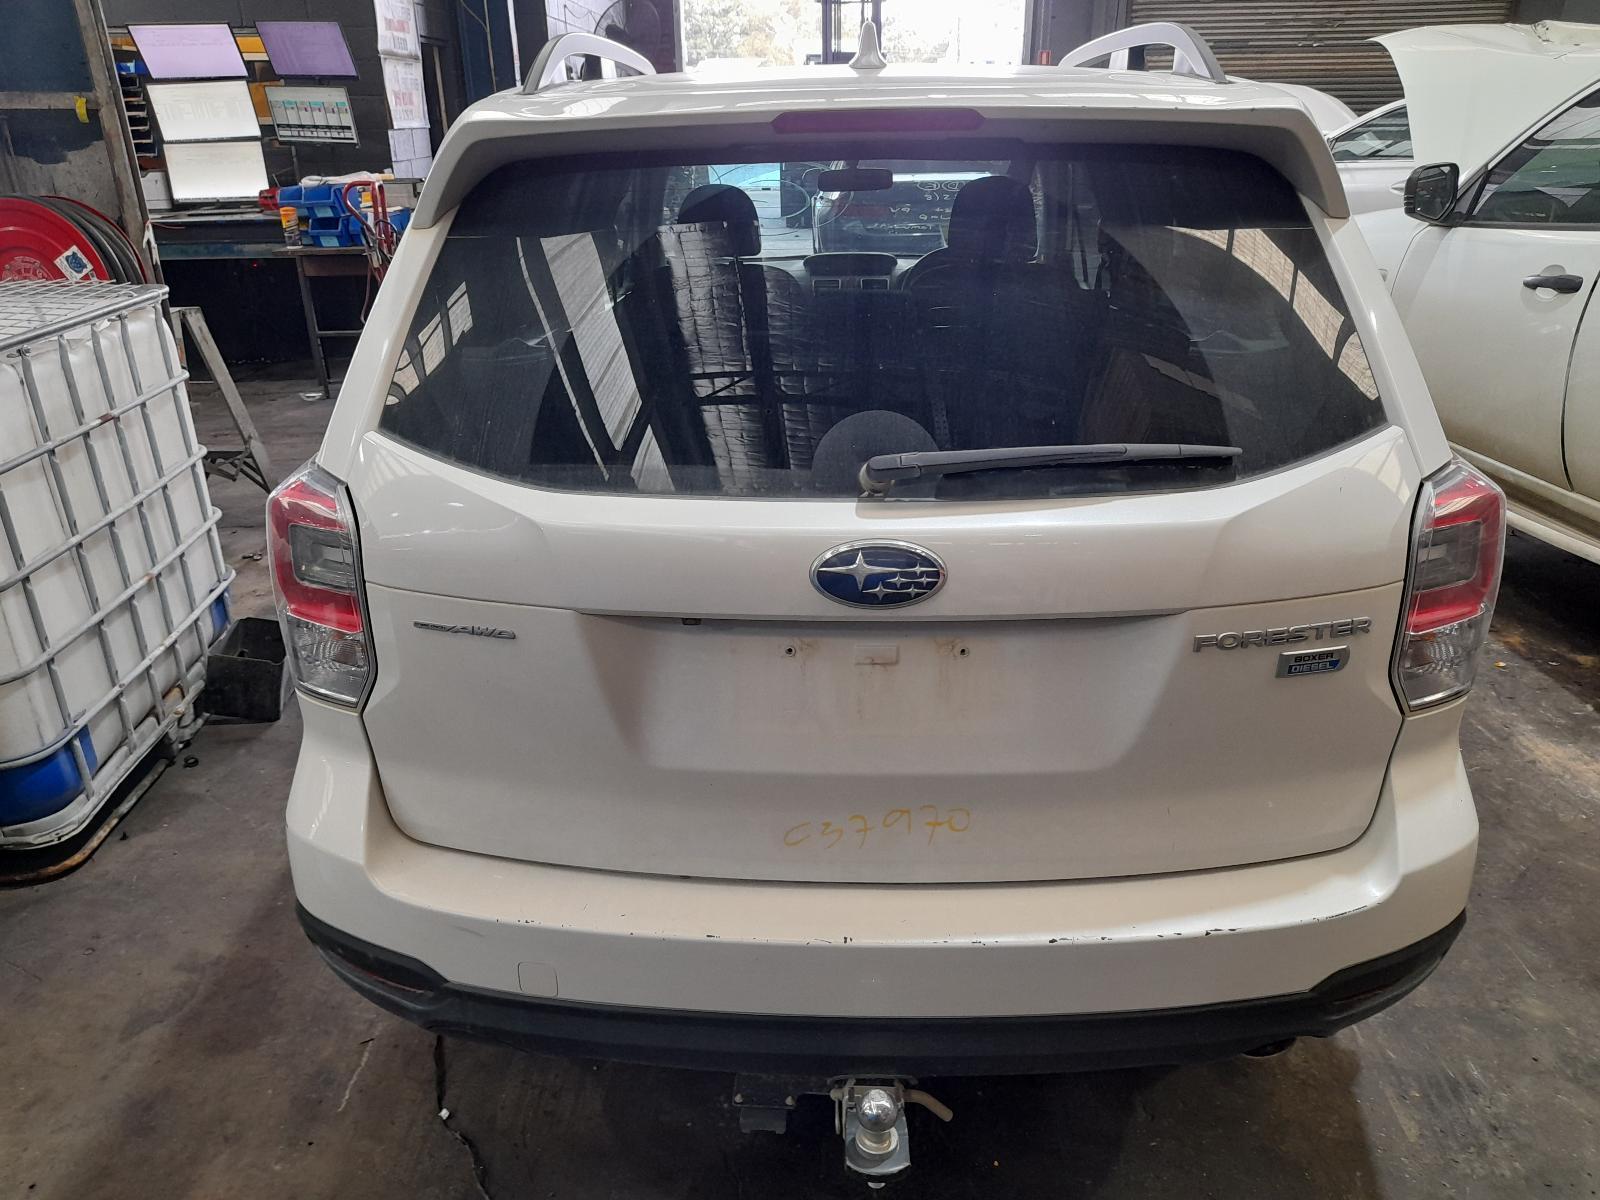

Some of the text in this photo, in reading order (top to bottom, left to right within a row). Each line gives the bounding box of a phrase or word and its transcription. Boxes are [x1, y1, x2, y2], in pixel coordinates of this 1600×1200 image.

[1193, 616, 1372, 653] FORESTER
[1294, 652, 1334, 663] BOXER
[1290, 660, 1336, 673] DIESEL
